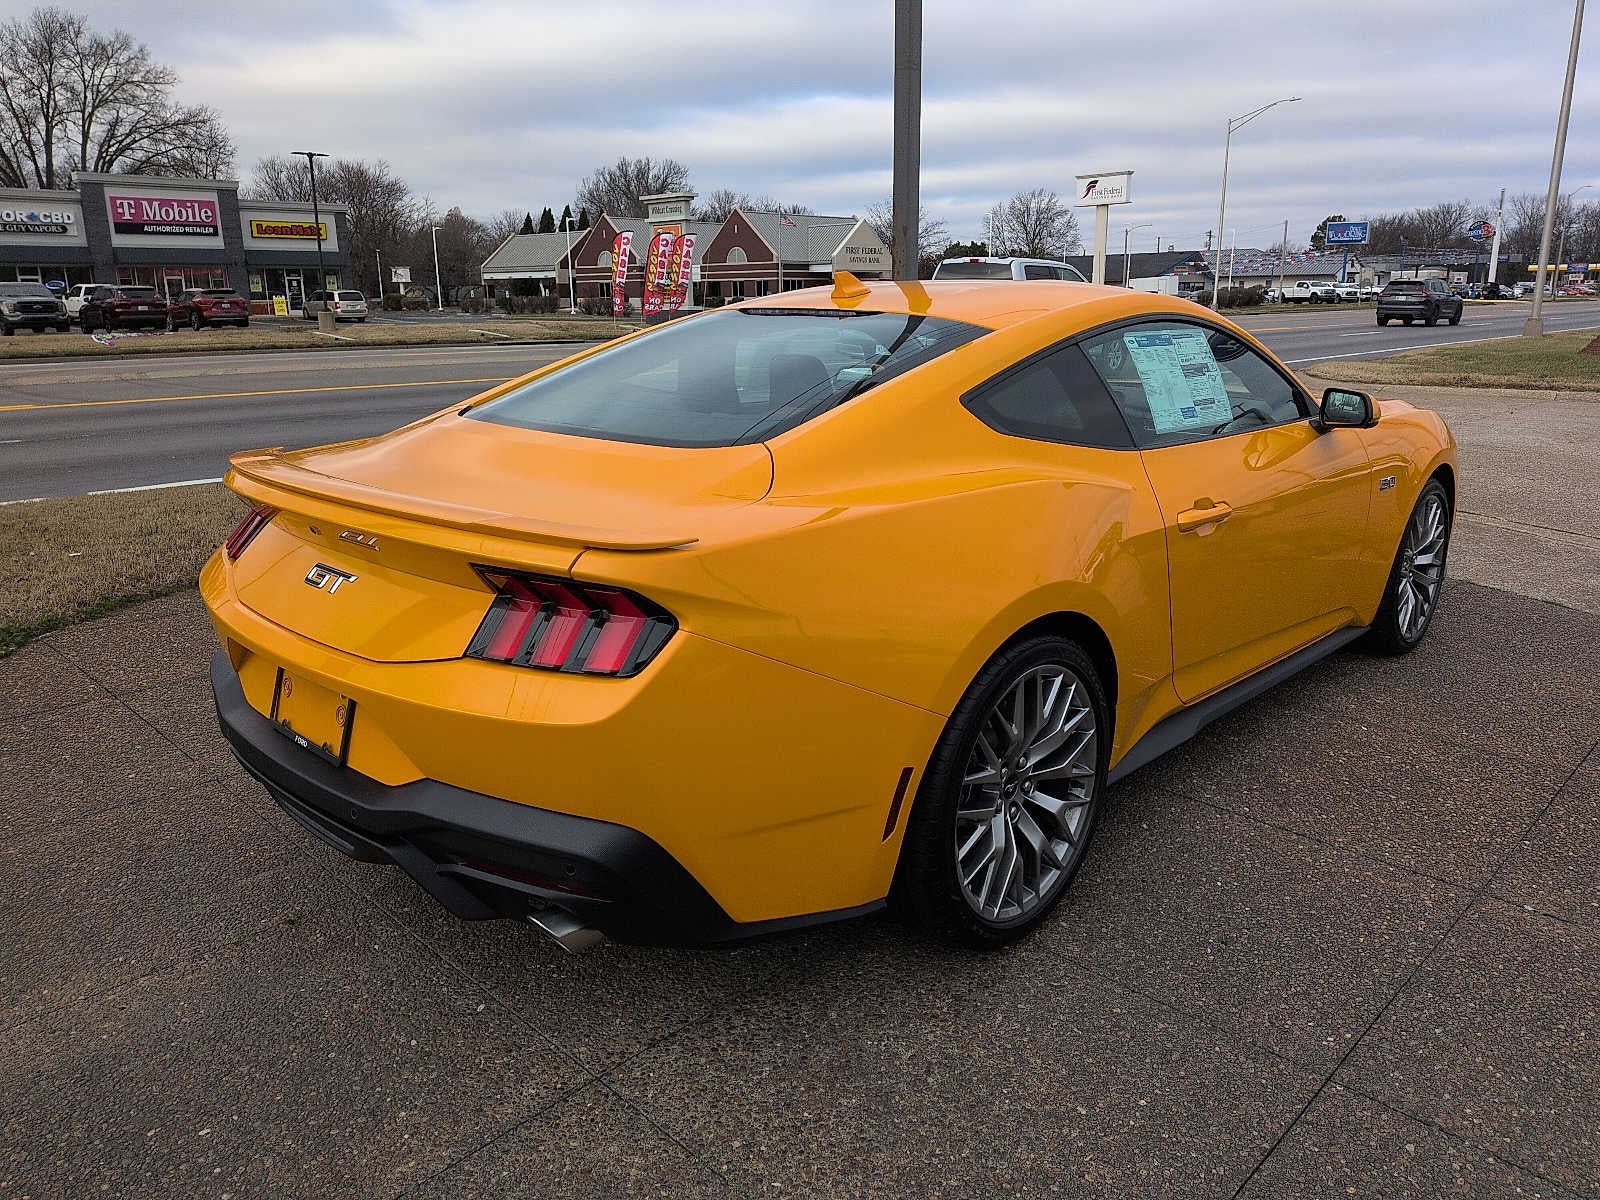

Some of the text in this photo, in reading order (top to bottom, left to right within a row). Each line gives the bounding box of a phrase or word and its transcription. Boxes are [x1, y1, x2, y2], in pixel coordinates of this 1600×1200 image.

[0, 210, 74, 224] OR CBD
[140, 200, 213, 223] Mobile
[6, 224, 27, 232] GUY
[27, 225, 63, 233] VAPORS
[144, 224, 214, 234] AUTHORIZED RETAILER
[304, 562, 360, 594] GT
